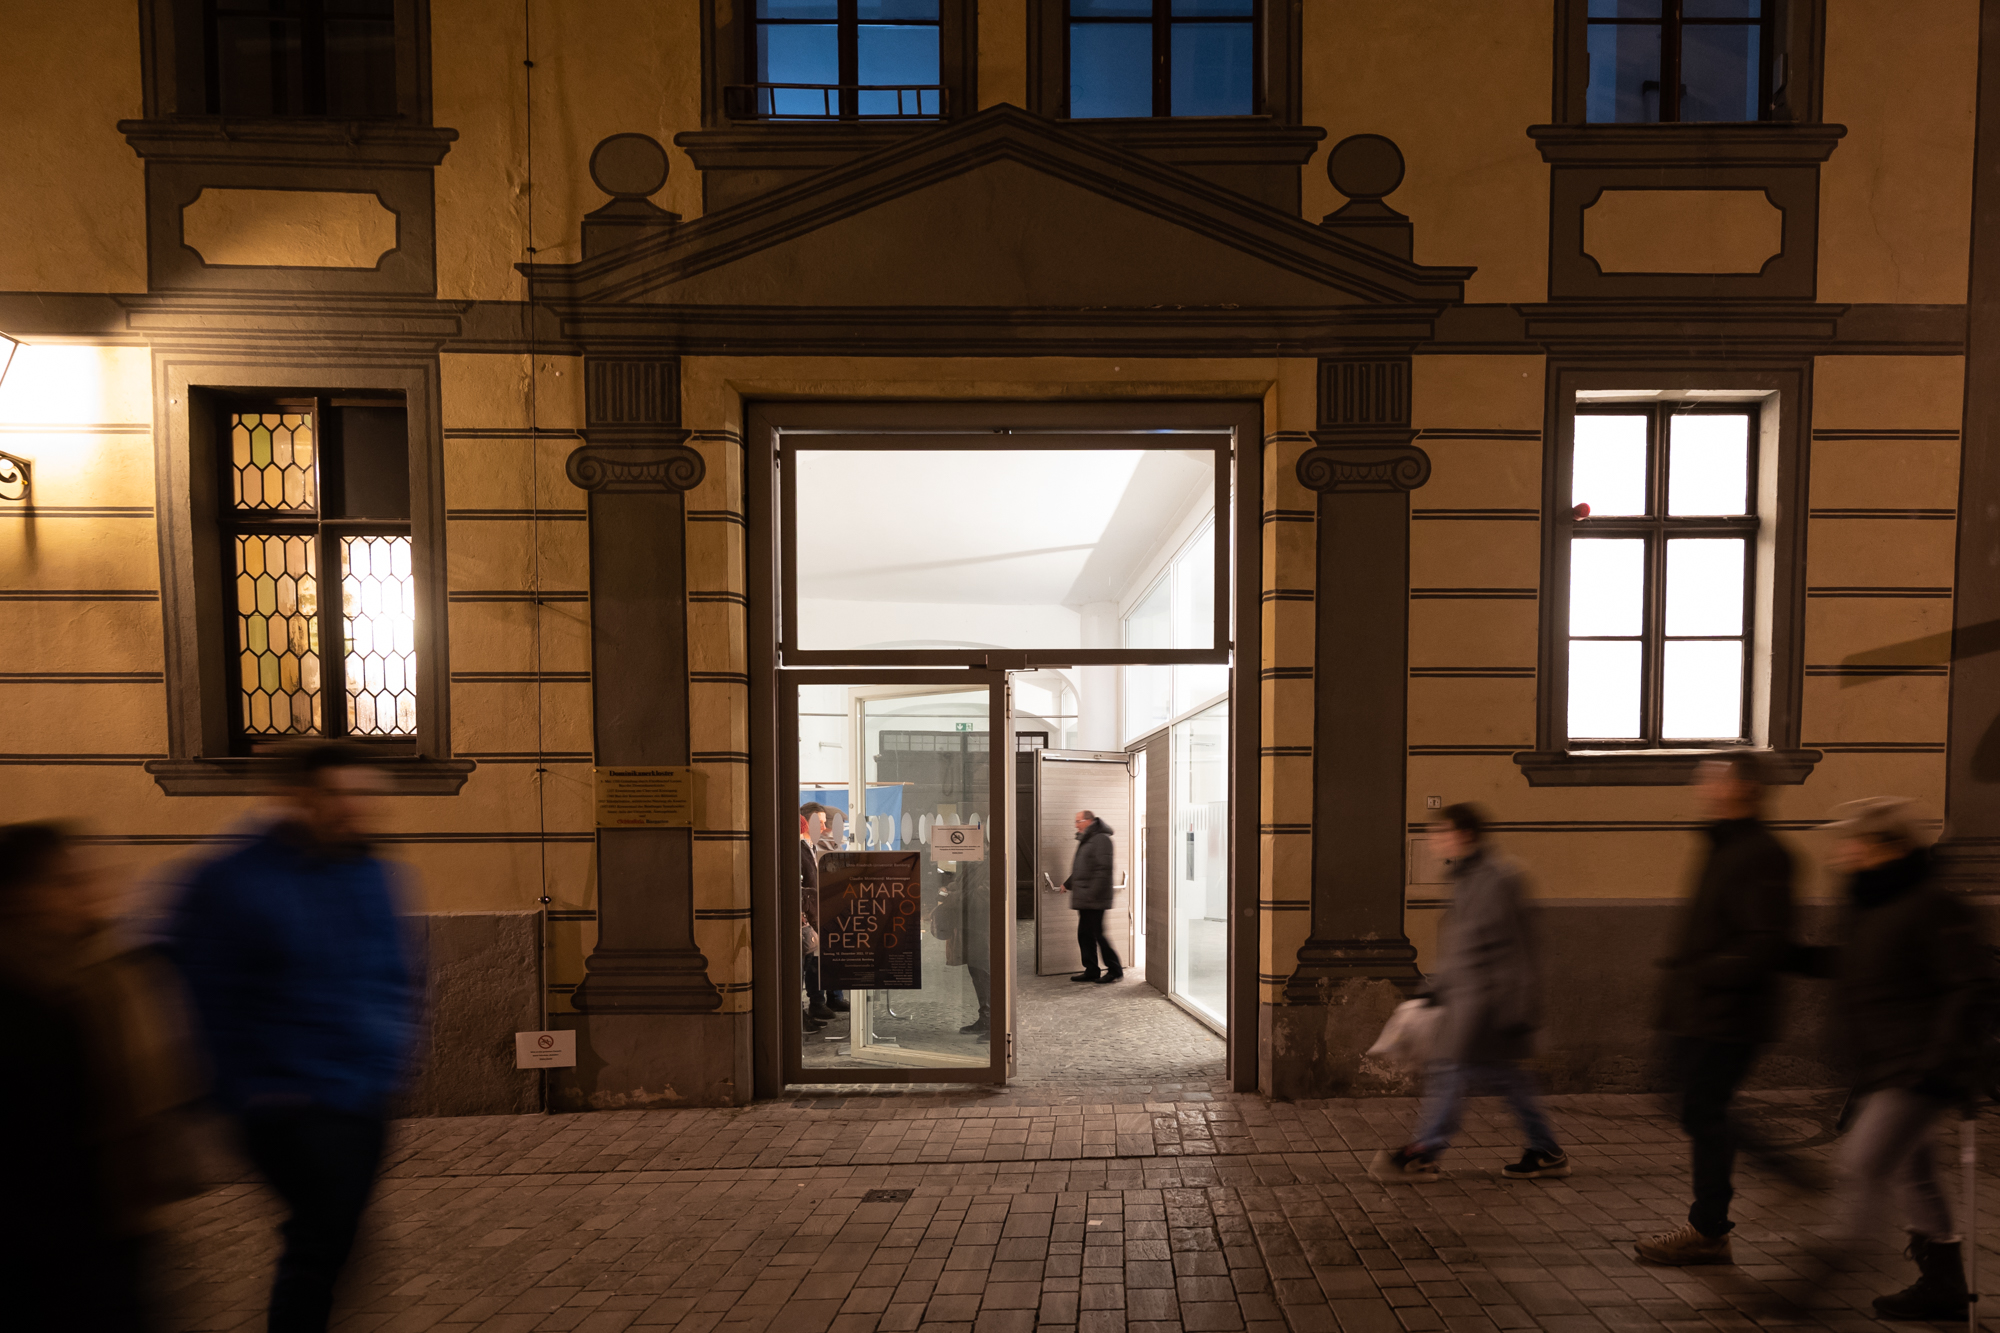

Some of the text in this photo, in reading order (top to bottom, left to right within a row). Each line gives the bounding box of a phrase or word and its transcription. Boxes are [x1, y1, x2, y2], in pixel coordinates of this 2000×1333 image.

[850, 899, 916, 916] IEN O
[836, 915, 906, 932] VES R
[828, 932, 898, 949] PER D
